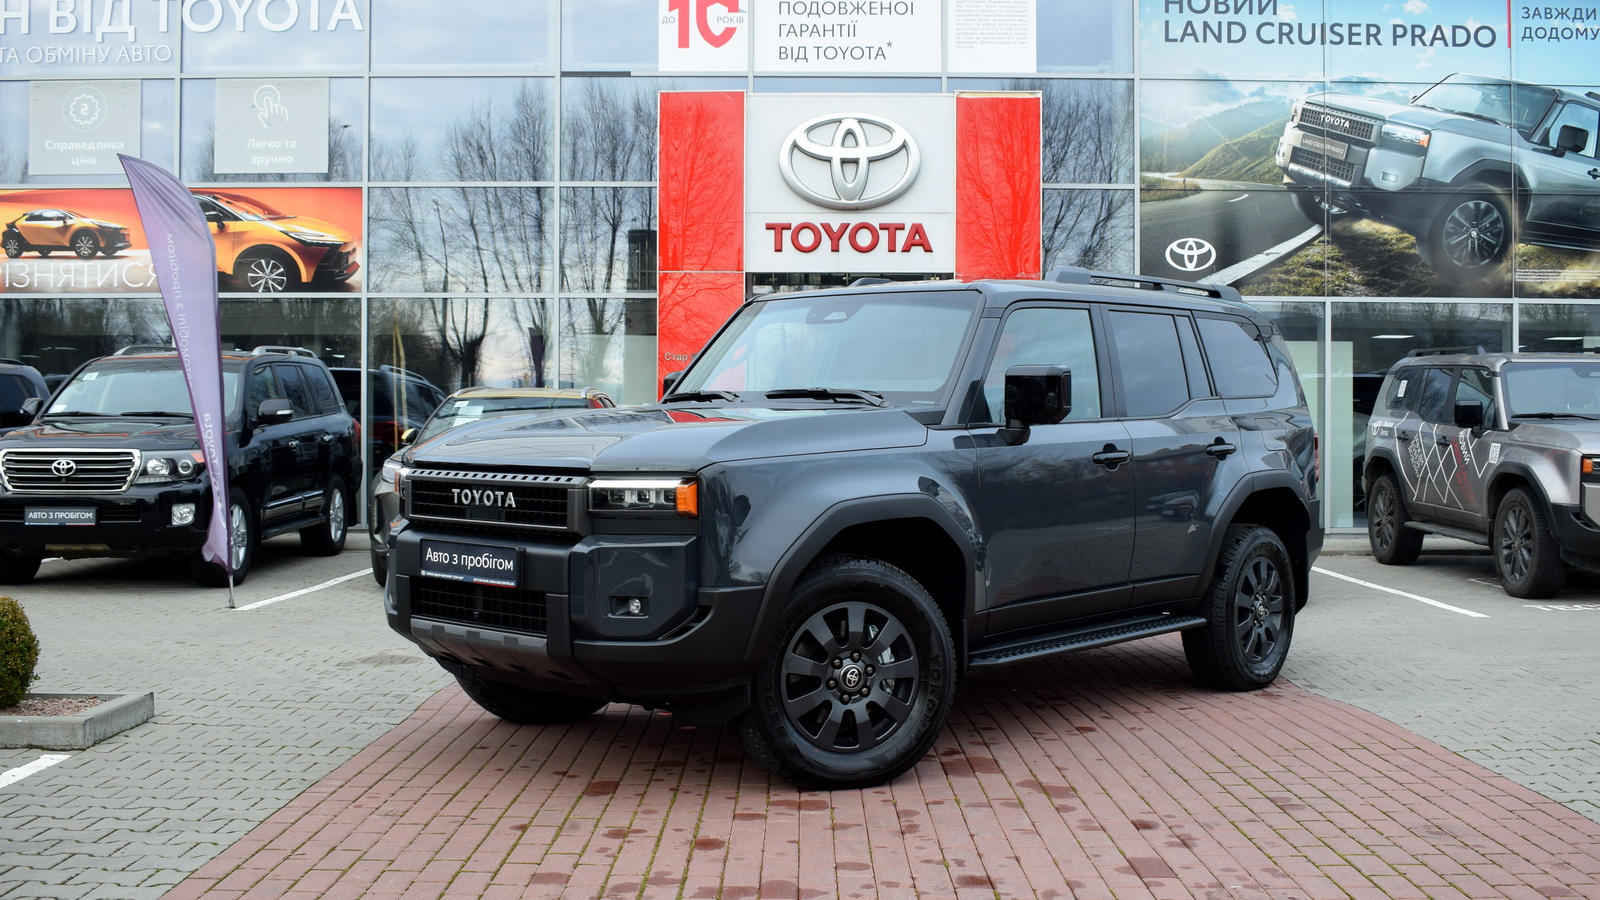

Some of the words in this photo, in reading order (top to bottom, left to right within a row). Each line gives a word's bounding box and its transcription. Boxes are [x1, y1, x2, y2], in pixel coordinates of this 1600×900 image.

[50, 0, 136, 43] ВІД
[155, 0, 365, 33] TOYOTA
[662, 16, 676, 25] ДО
[716, 16, 745, 24] РОКІВ
[1521, 6, 1597, 23] ЗАВЖДИ
[778, 20, 858, 38] ГАРАНТІЇ
[1164, 20, 1247, 44] LAND
[1256, 22, 1383, 46] CRUISER
[1392, 24, 1497, 48] PRADO
[1521, 26, 1600, 43] ДОДОМУ
[26, 46, 112, 64] ОБМІНУ
[116, 45, 173, 63] АВТО
[778, 46, 808, 63] ВІД
[1320, 114, 1350, 128] TOYOTA
[45, 140, 124, 152] Справедлива
[247, 138, 281, 149] Легко
[283, 140, 297, 148] та
[72, 154, 97, 166] ціна
[250, 156, 293, 166] зручно
[765, 221, 933, 253] TOYOTA
[0, 262, 158, 288] ІЗНЯТИСЯ
[451, 488, 517, 508] TOYOTA
[28, 511, 48, 519] АВТО
[48, 511, 54, 519] З
[54, 511, 93, 519] ПРОБІГОМ
[425, 547, 450, 564] Авто
[452, 553, 459, 565] з
[461, 553, 514, 571] пробігом
